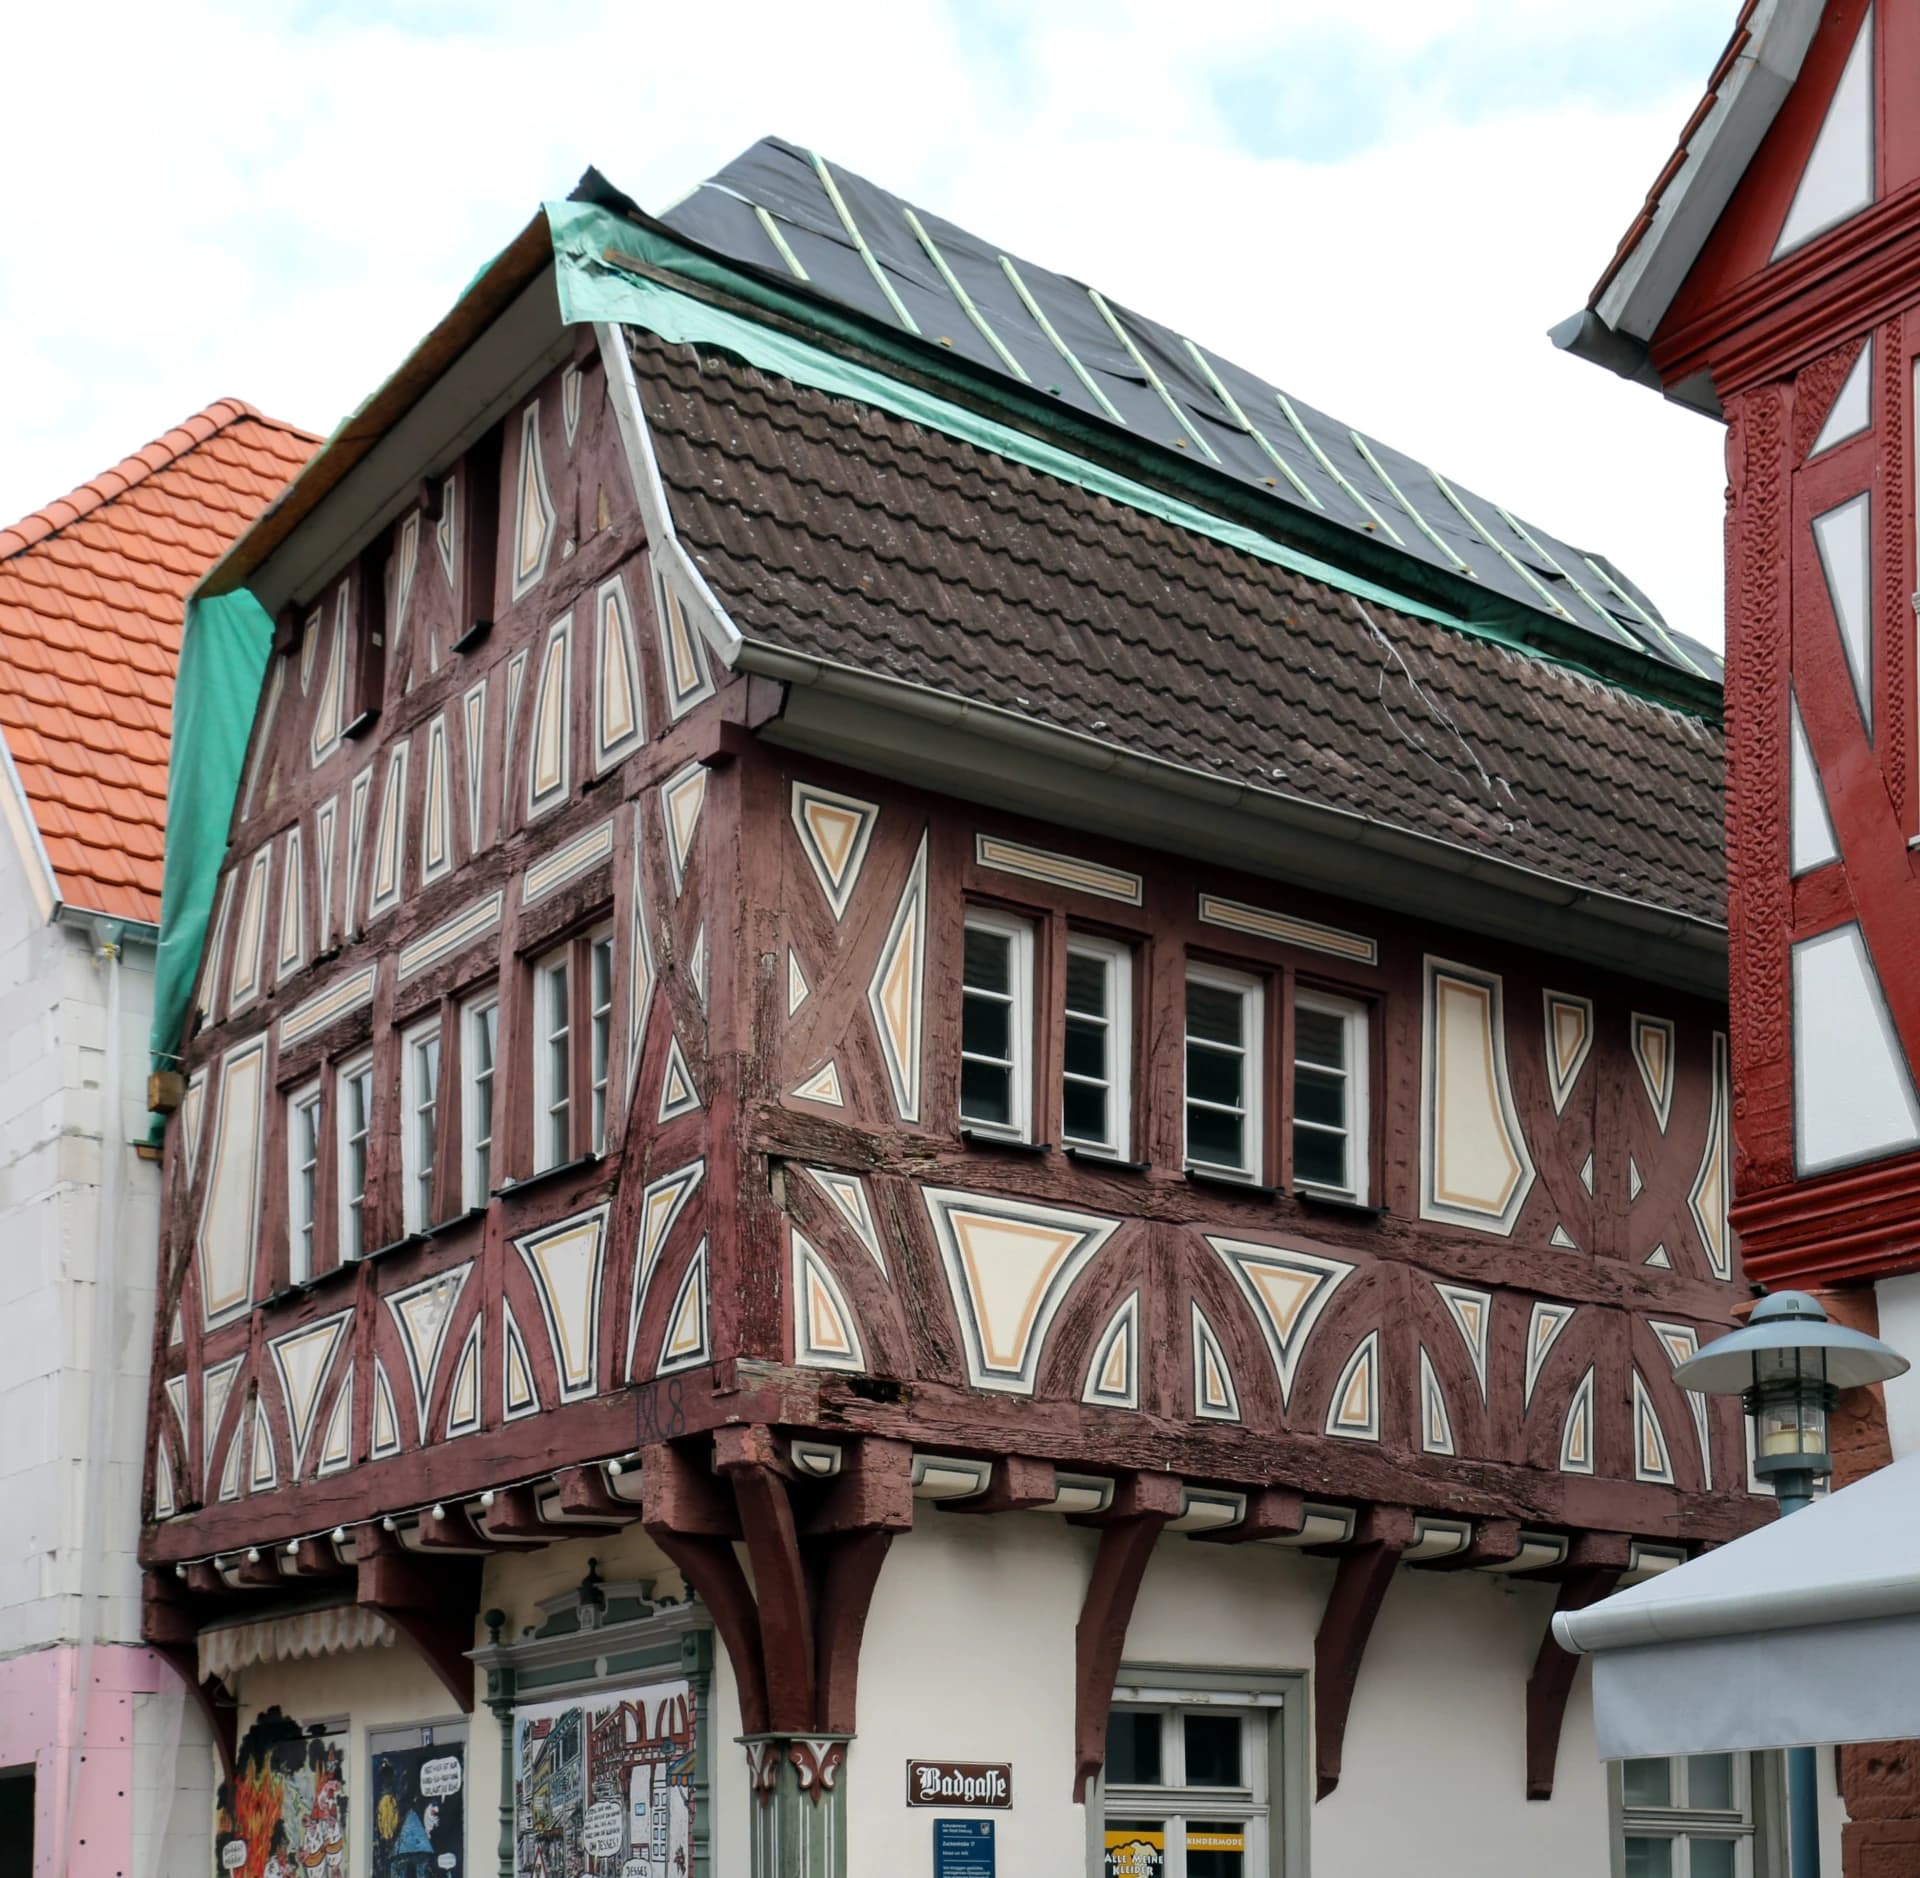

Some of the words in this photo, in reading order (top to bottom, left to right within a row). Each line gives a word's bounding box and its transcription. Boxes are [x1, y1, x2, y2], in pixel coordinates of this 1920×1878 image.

[915, 1766, 1007, 1804] Badgasse
[1104, 1853, 1127, 1863] ALLE
[1132, 1855, 1164, 1865] MEINE
[1112, 1865, 1154, 1876] KLEIDER
